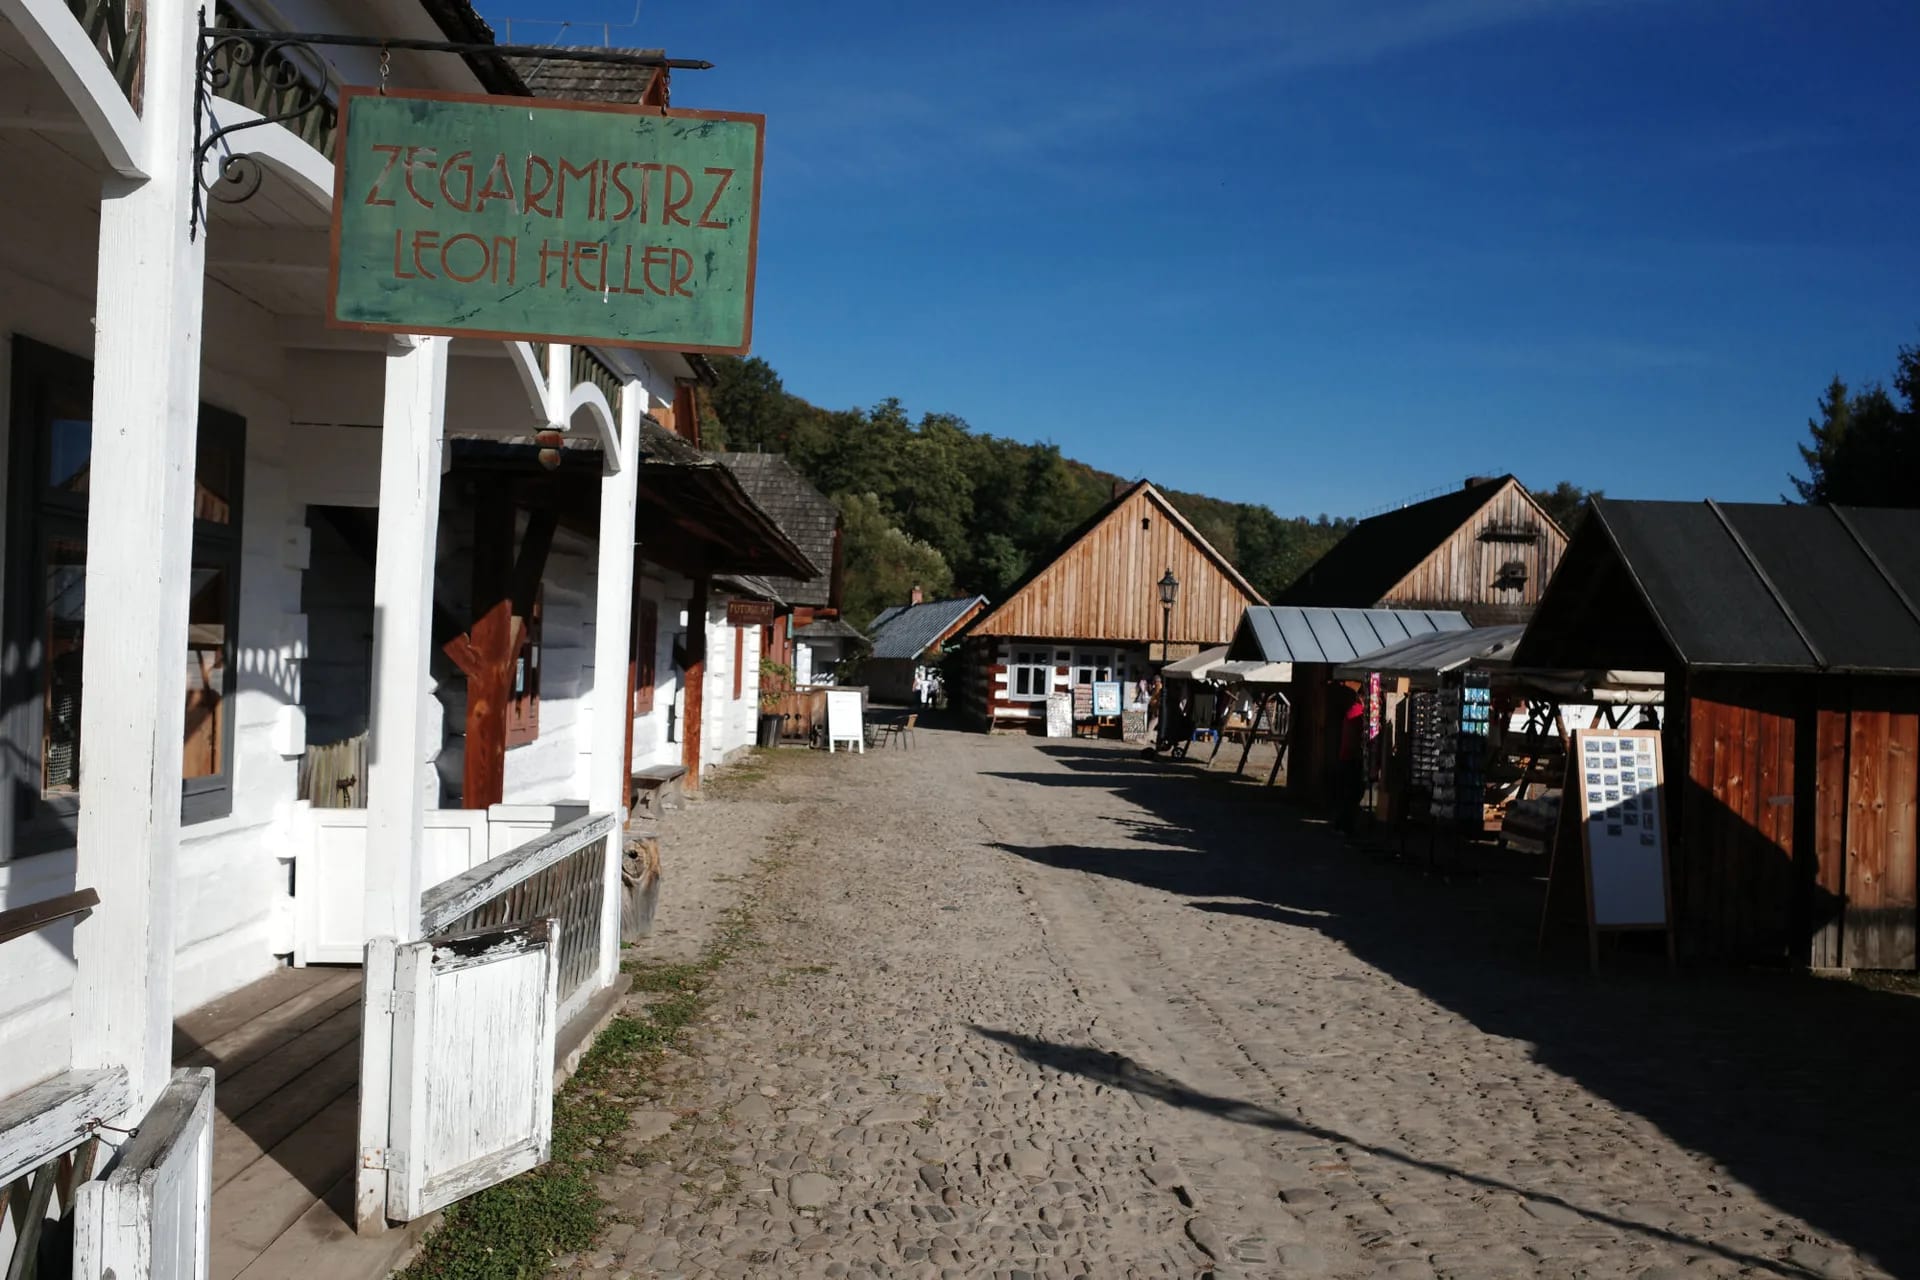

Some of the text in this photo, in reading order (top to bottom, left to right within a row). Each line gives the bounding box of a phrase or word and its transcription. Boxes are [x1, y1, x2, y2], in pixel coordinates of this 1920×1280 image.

[364, 144, 737, 229] ZEGARMISTRZ
[394, 229, 694, 298] LEON HELLER
